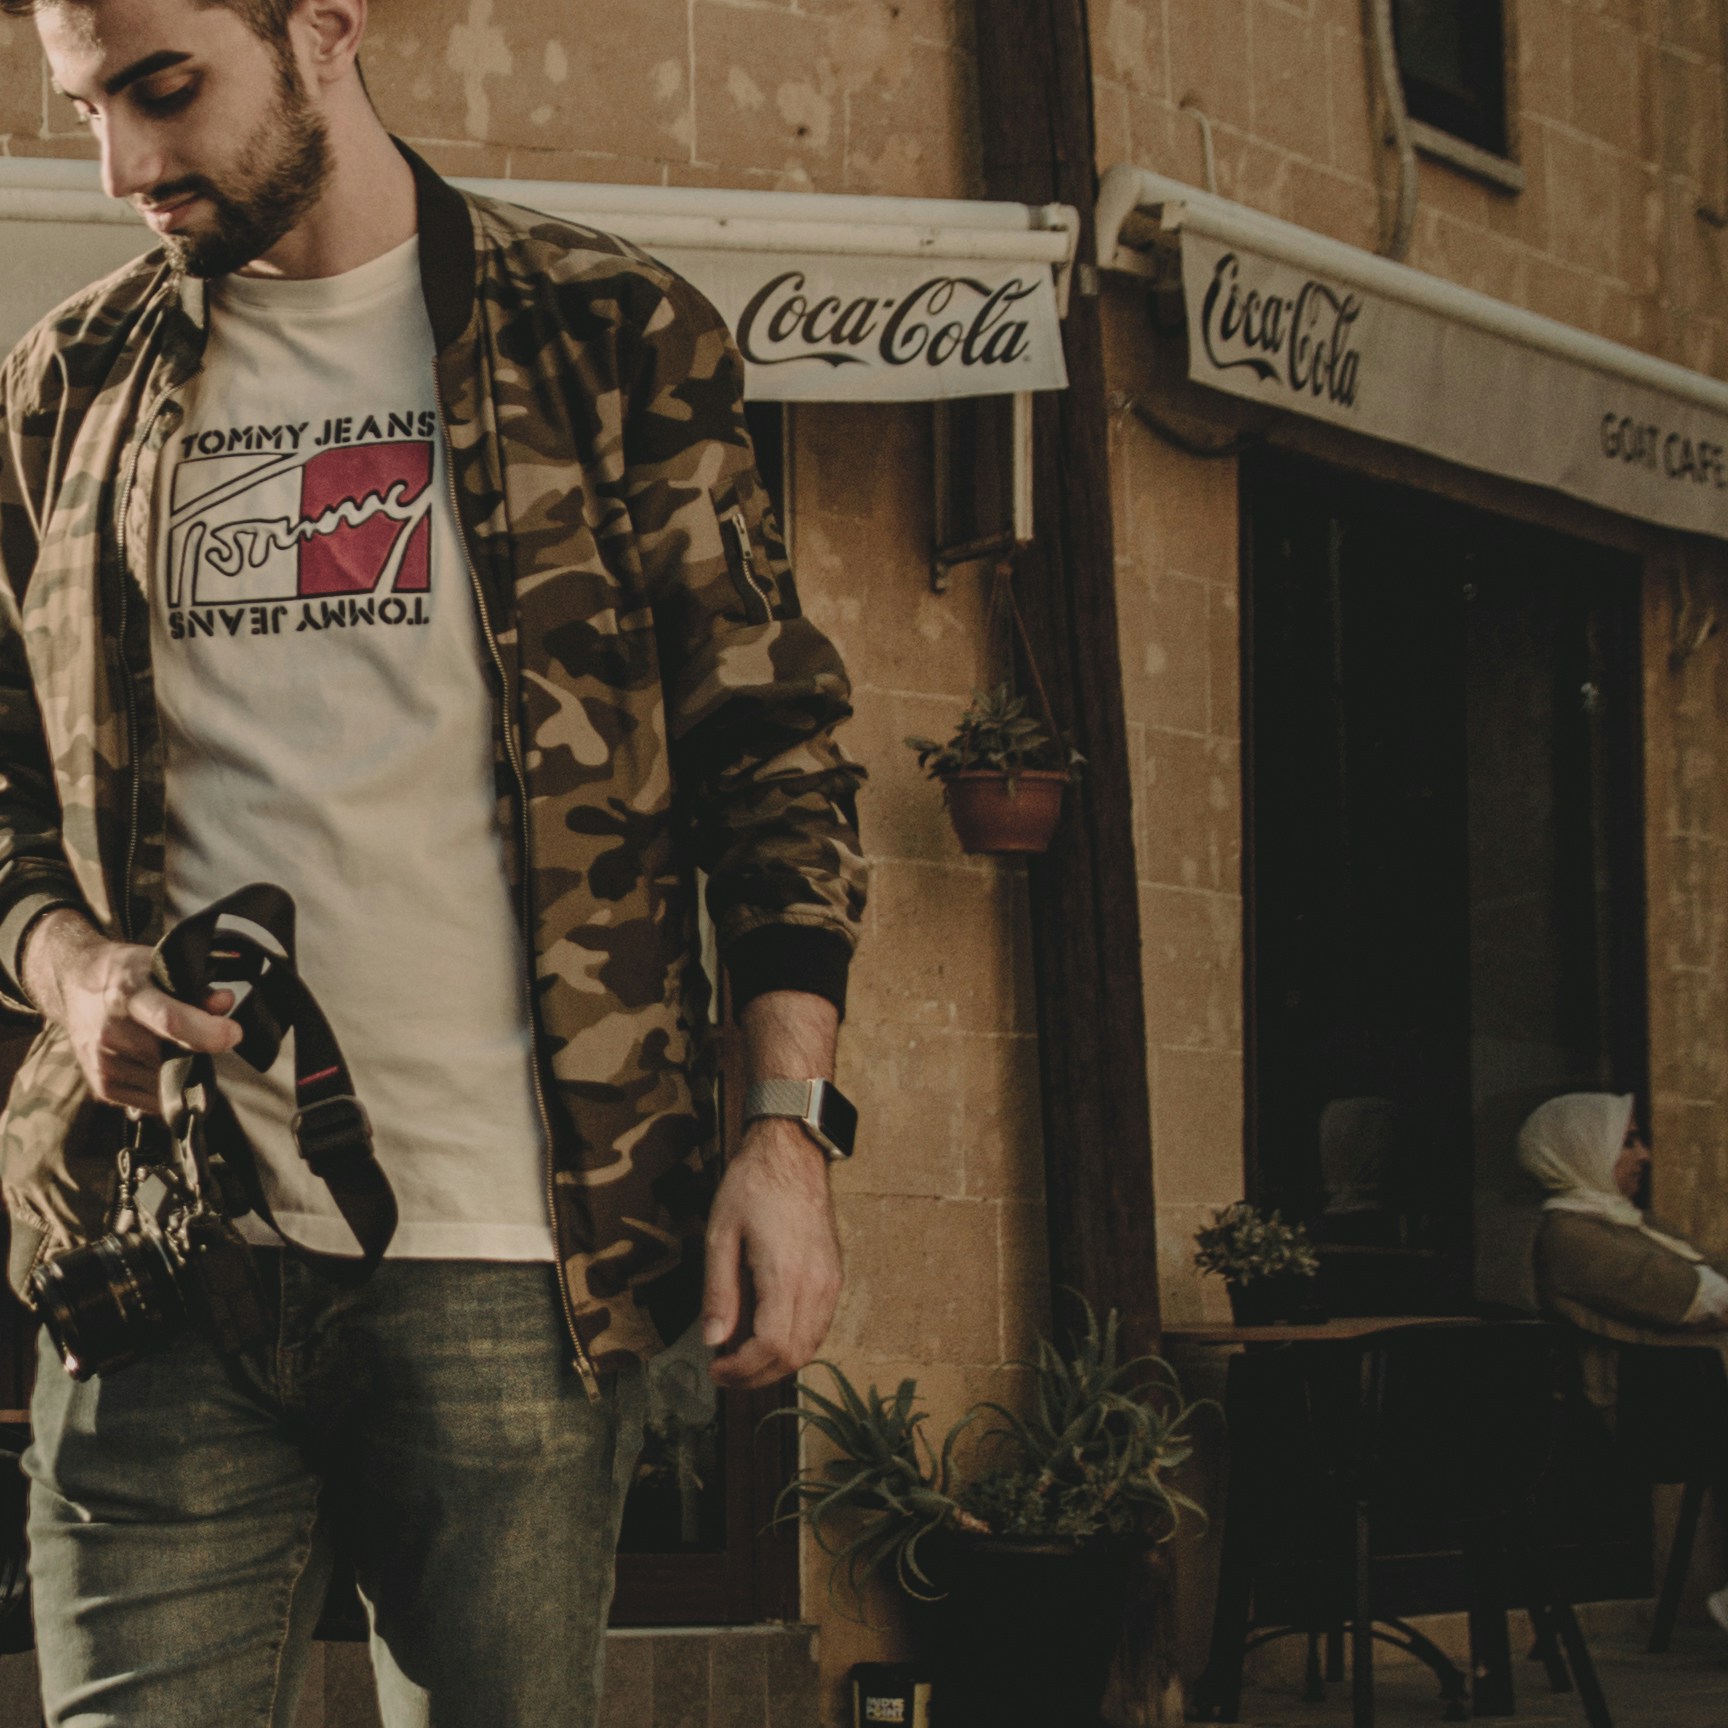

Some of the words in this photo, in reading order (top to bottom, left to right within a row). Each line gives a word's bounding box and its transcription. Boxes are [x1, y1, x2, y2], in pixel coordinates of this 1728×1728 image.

[736, 271, 1042, 367] Coca-Cola
[1202, 251, 1363, 409] Coca-Cola
[181, 422, 309, 458] TOMMY
[314, 411, 436, 446] JEANS
[1600, 412, 1659, 471] GOAT
[169, 606, 288, 639] JEANS
[296, 597, 430, 631] TOMMY
